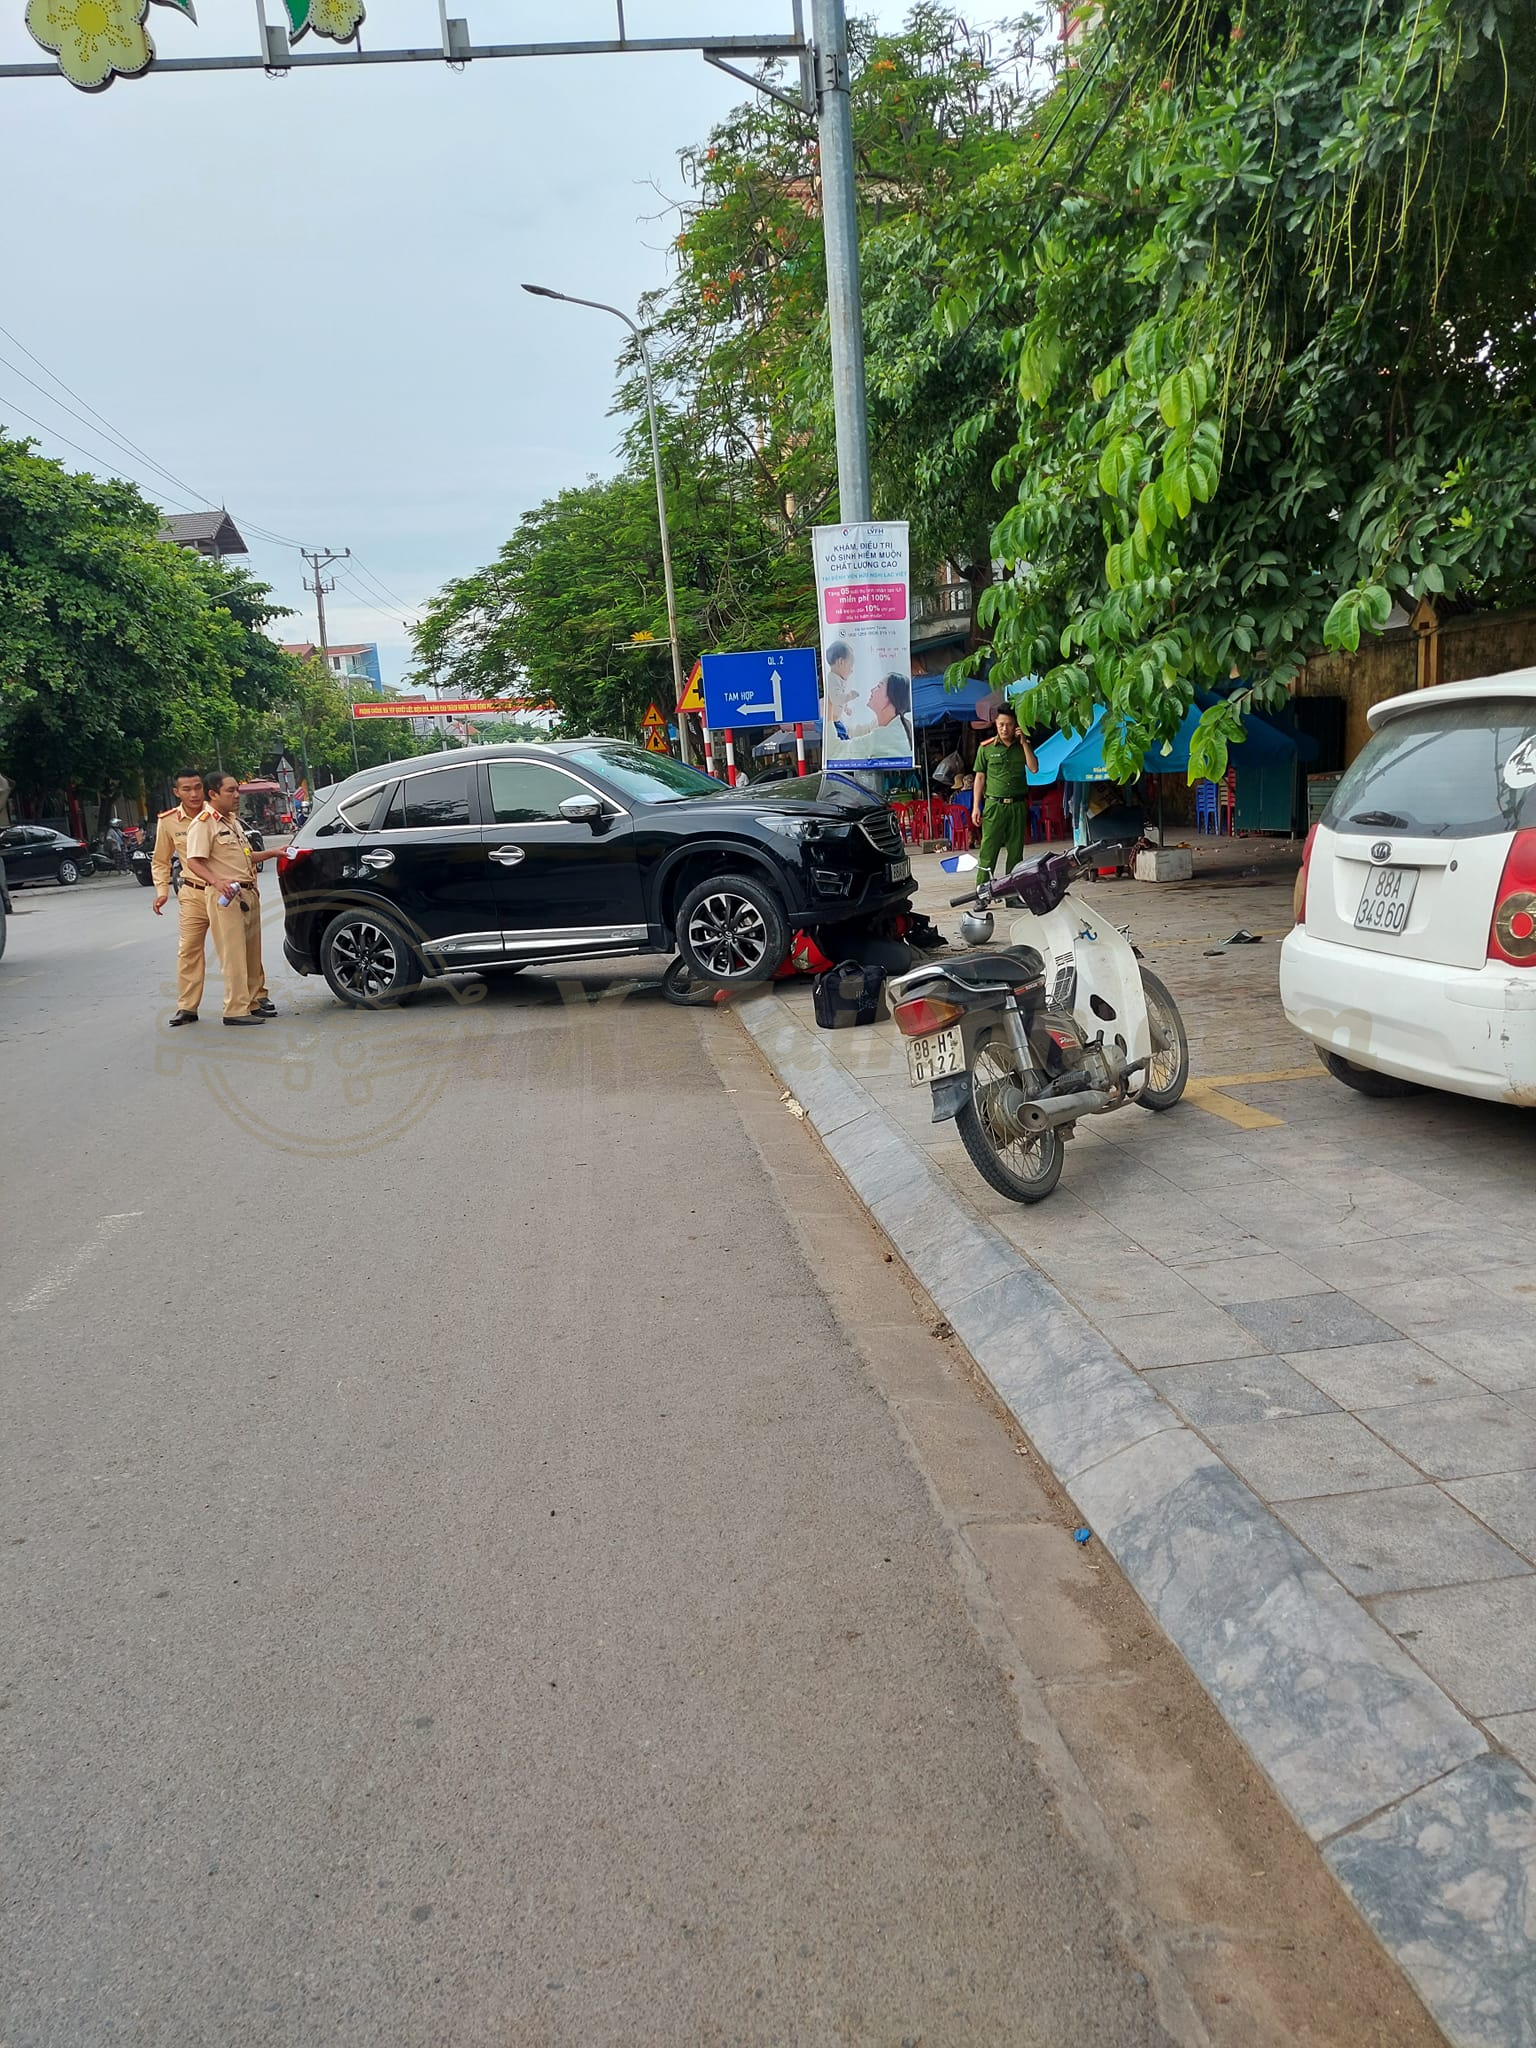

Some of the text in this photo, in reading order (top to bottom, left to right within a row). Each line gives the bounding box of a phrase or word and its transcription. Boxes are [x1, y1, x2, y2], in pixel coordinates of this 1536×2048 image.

[825, 553, 837, 562] VÔ
[838, 552, 857, 561] SINH
[881, 560, 898, 568] CAO
[872, 593, 891, 602] 100%
[865, 604, 881, 613] 10%
[724, 692, 740, 702] TAM
[1373, 844, 1389, 857] KIA
[1375, 871, 1402, 899] 88A
[1358, 898, 1405, 930] 349.60
[610, 928, 641, 939] CX-5
[916, 1052, 957, 1081] 0122
